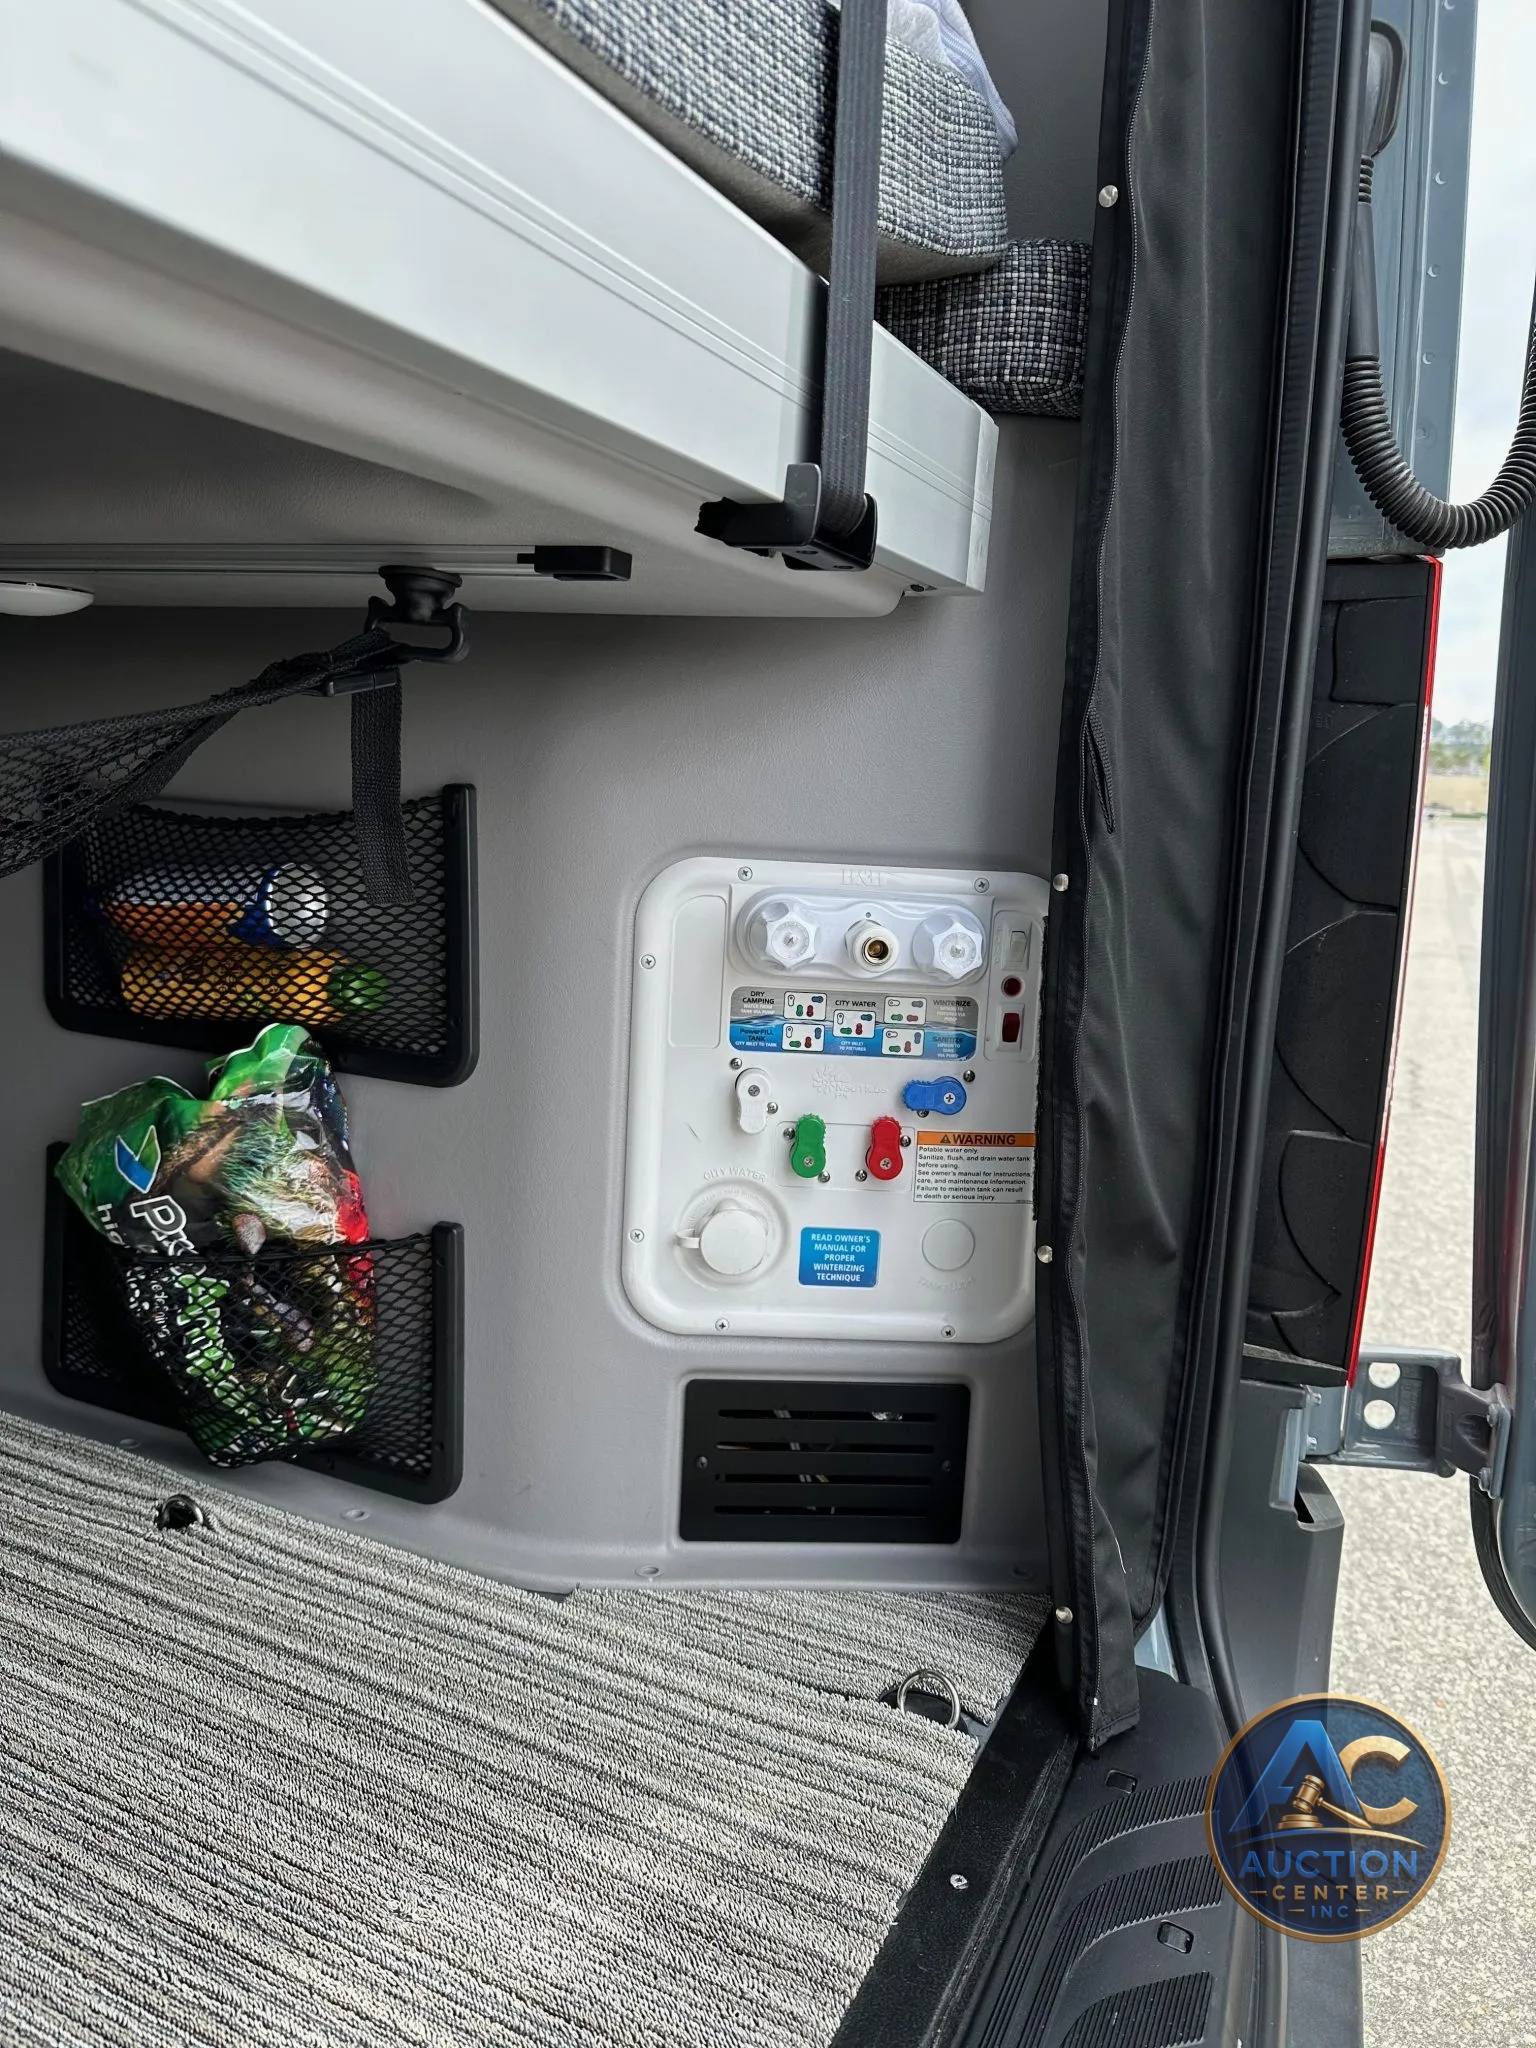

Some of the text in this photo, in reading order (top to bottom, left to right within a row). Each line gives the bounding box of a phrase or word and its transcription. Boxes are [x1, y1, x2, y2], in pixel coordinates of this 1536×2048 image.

[953, 1134, 1016, 1145] WARNING
[703, 1166, 766, 1182] CITY WATER
[834, 1234, 871, 1243] OWNER'S
[814, 1244, 848, 1252] MANUAL
[824, 1254, 855, 1262] PROPER
[813, 1263, 864, 1272] WINTERIZING
[816, 1273, 860, 1282] TECHNIQUE
